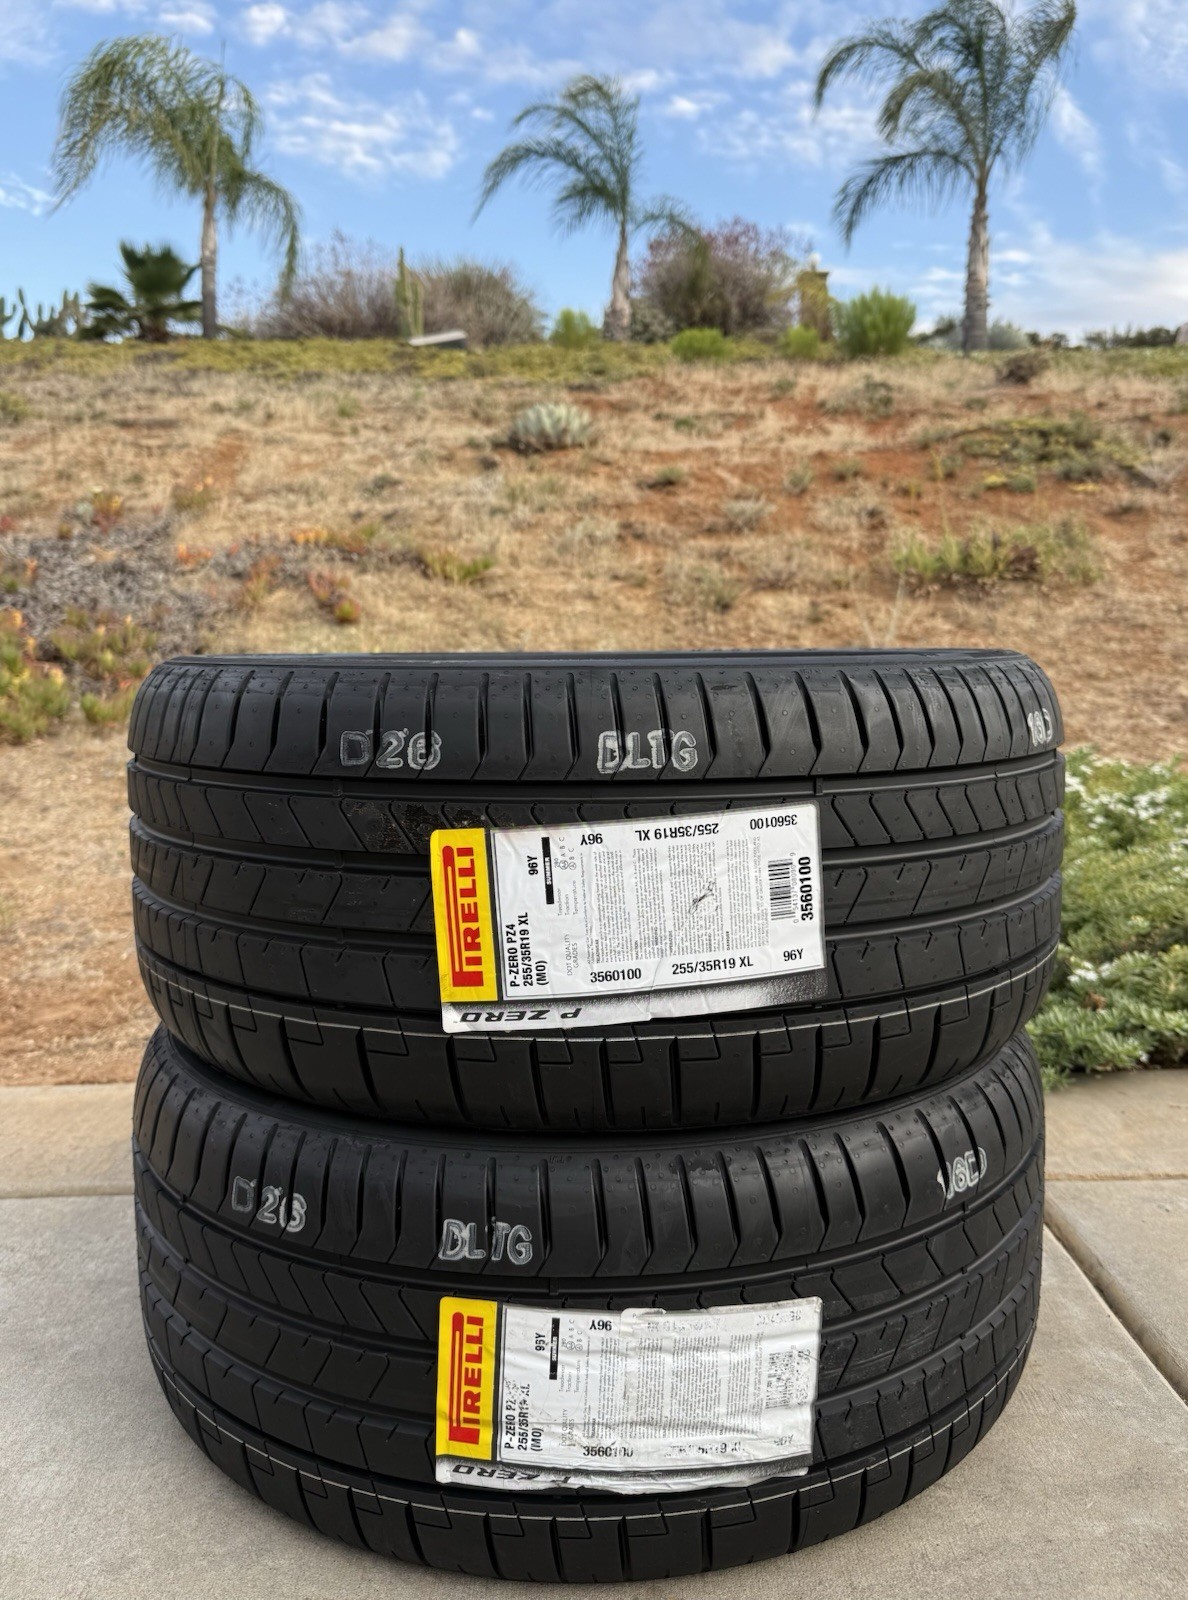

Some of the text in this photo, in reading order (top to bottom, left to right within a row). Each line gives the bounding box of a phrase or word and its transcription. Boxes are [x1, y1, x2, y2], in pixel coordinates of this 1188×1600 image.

[634, 822, 720, 841] 255/35R19 XL
[750, 814, 798, 830] 3560100
[580, 832, 603, 846] 96Y
[526, 855, 539, 876] 96Y
[544, 856, 552, 885] SUMMER
[798, 856, 813, 921] 3560100
[442, 845, 484, 987] PIRELLI
[505, 924, 520, 987] P-ZERO PZ4
[518, 912, 534, 987] 255/35R19 XL
[571, 942, 579, 969] GRADES
[783, 948, 804, 962] 96Y
[535, 960, 549, 986] (MO)
[590, 968, 642, 983] 3560100
[672, 955, 754, 975] 255/35R19 XL
[460, 1007, 583, 1023] P ZERO
[589, 1319, 612, 1332] 96Y
[448, 1312, 484, 1445] PIRELLI
